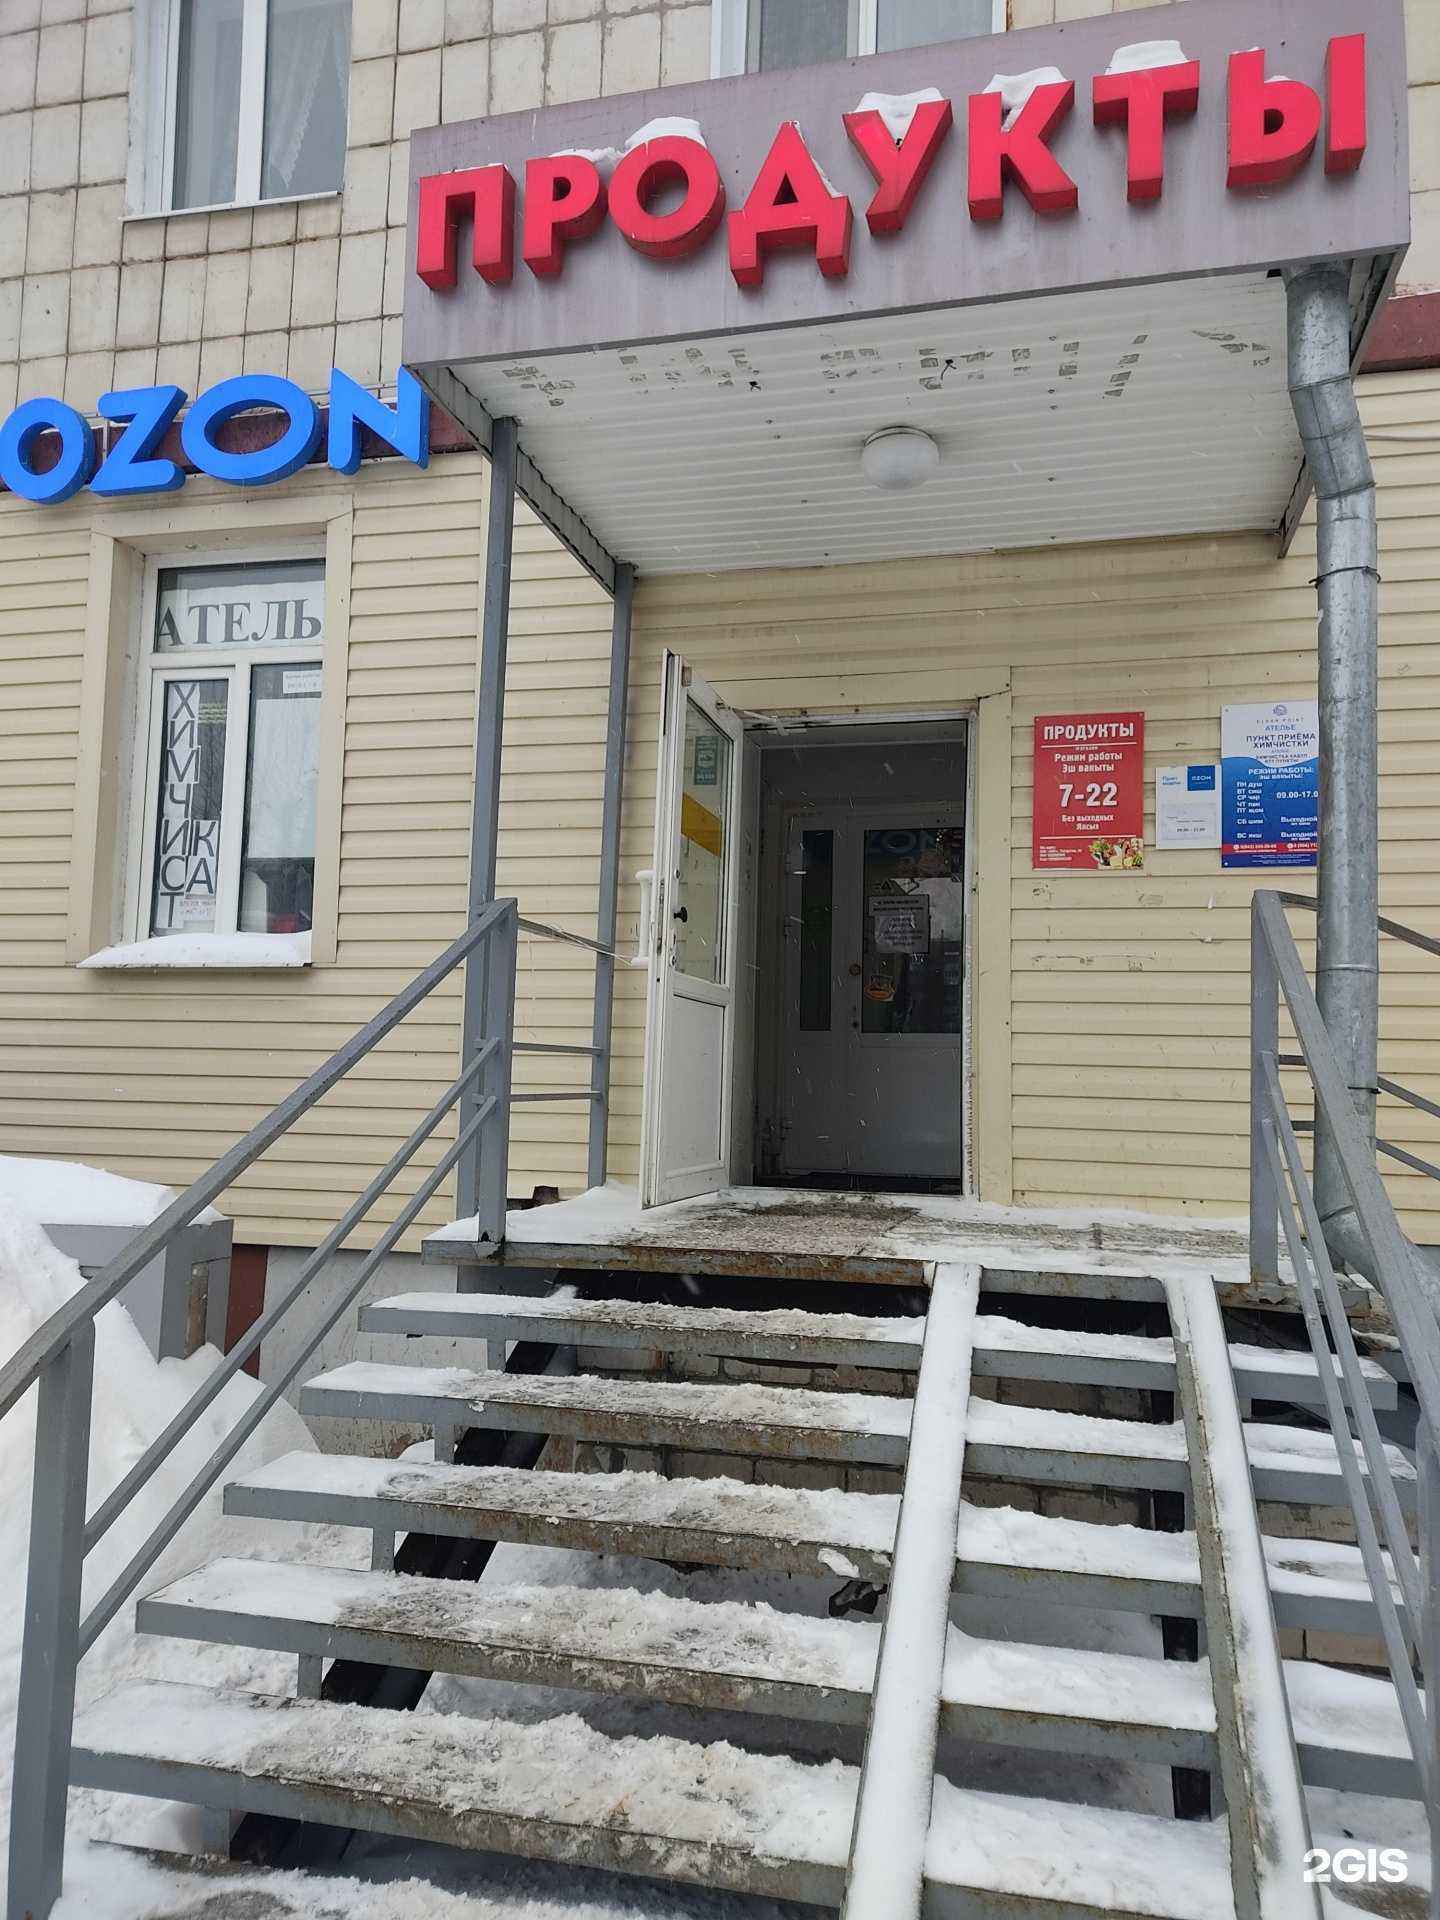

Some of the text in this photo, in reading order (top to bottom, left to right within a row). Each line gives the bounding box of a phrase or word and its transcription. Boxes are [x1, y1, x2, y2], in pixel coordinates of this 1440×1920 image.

[416, 32, 1367, 291] ПРОДУКТЫ
[0, 365, 430, 505] OZON
[158, 598, 322, 647] АТЕЛЬ
[1043, 723, 1135, 741] ПРОДУКТЫ
[1246, 734, 1277, 743] ПУНКТ
[1253, 740, 1309, 749] ХИМЧИСТКИ
[1054, 752, 1123, 762] Режим работы
[1061, 763, 1114, 773] Эш вакыты
[1059, 782, 1117, 807] 7-22
[1061, 814, 1114, 822] Без выходных
[1280, 815, 1318, 823] Выходной
